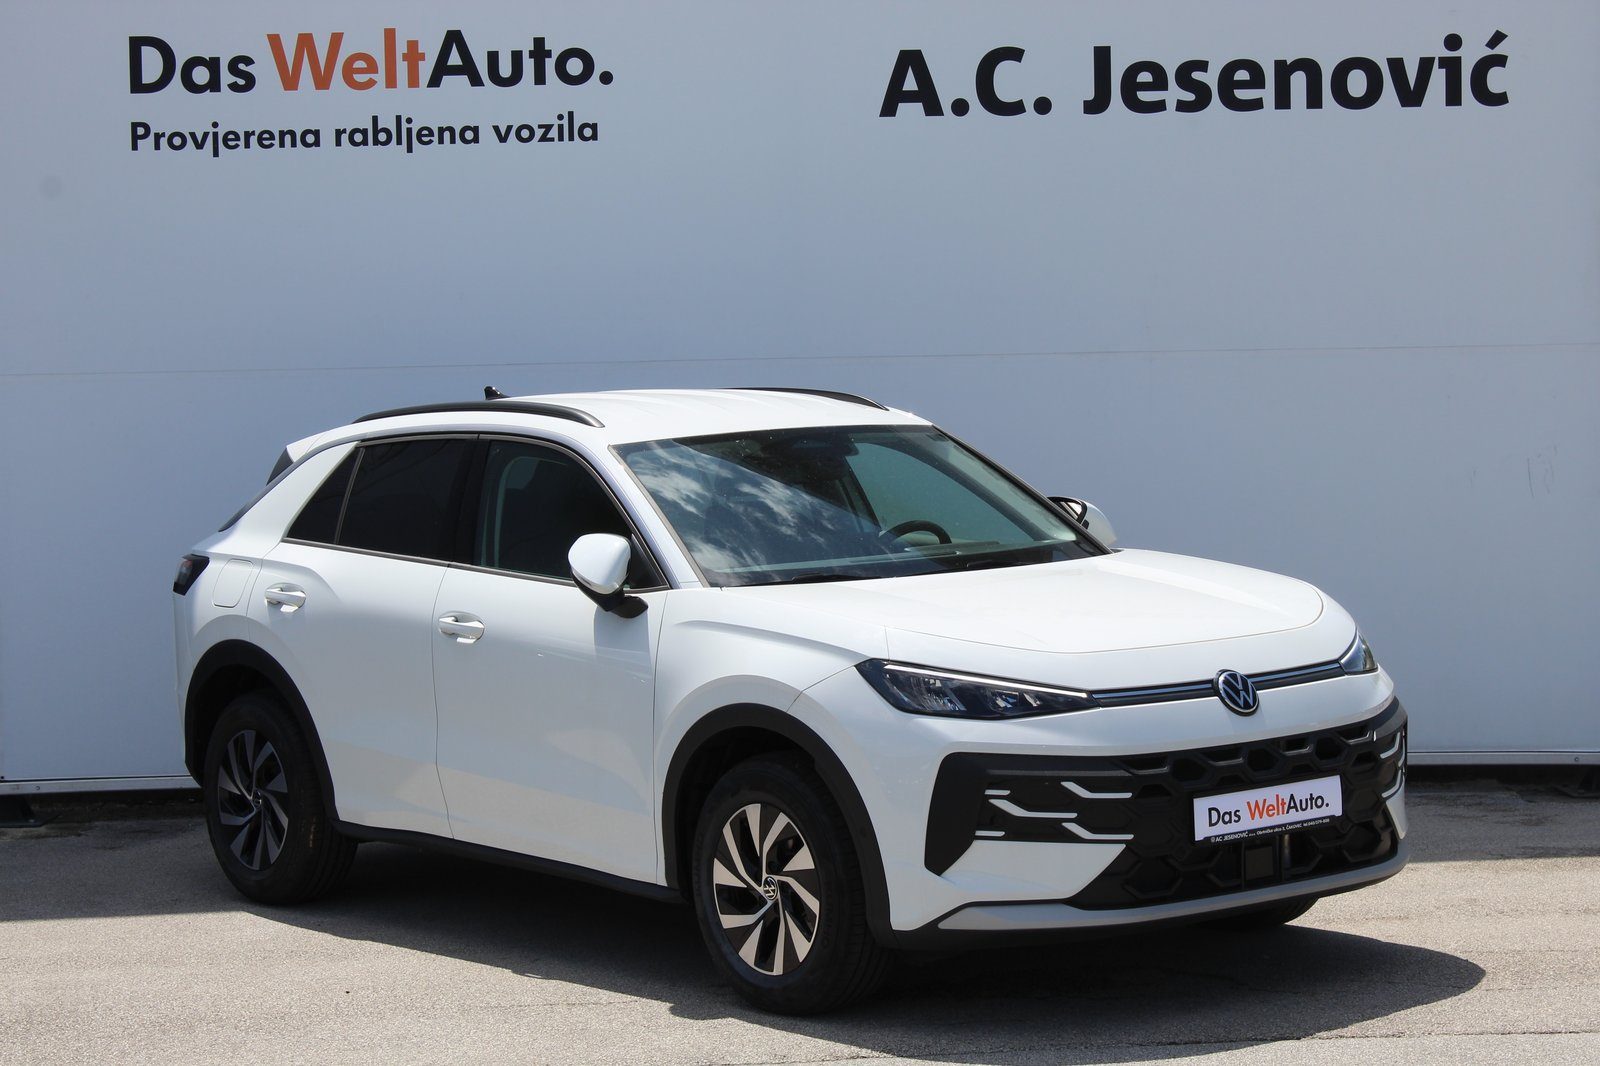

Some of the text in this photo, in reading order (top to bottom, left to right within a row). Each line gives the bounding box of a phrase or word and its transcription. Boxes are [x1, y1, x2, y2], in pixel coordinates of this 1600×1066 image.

[129, 28, 614, 94] Das WeltAuto.
[879, 29, 1510, 118] A.C. Jesenović
[130, 110, 599, 157] Provjerena rabljena vozila
[1208, 793, 1330, 828] Das WeltAuto.
